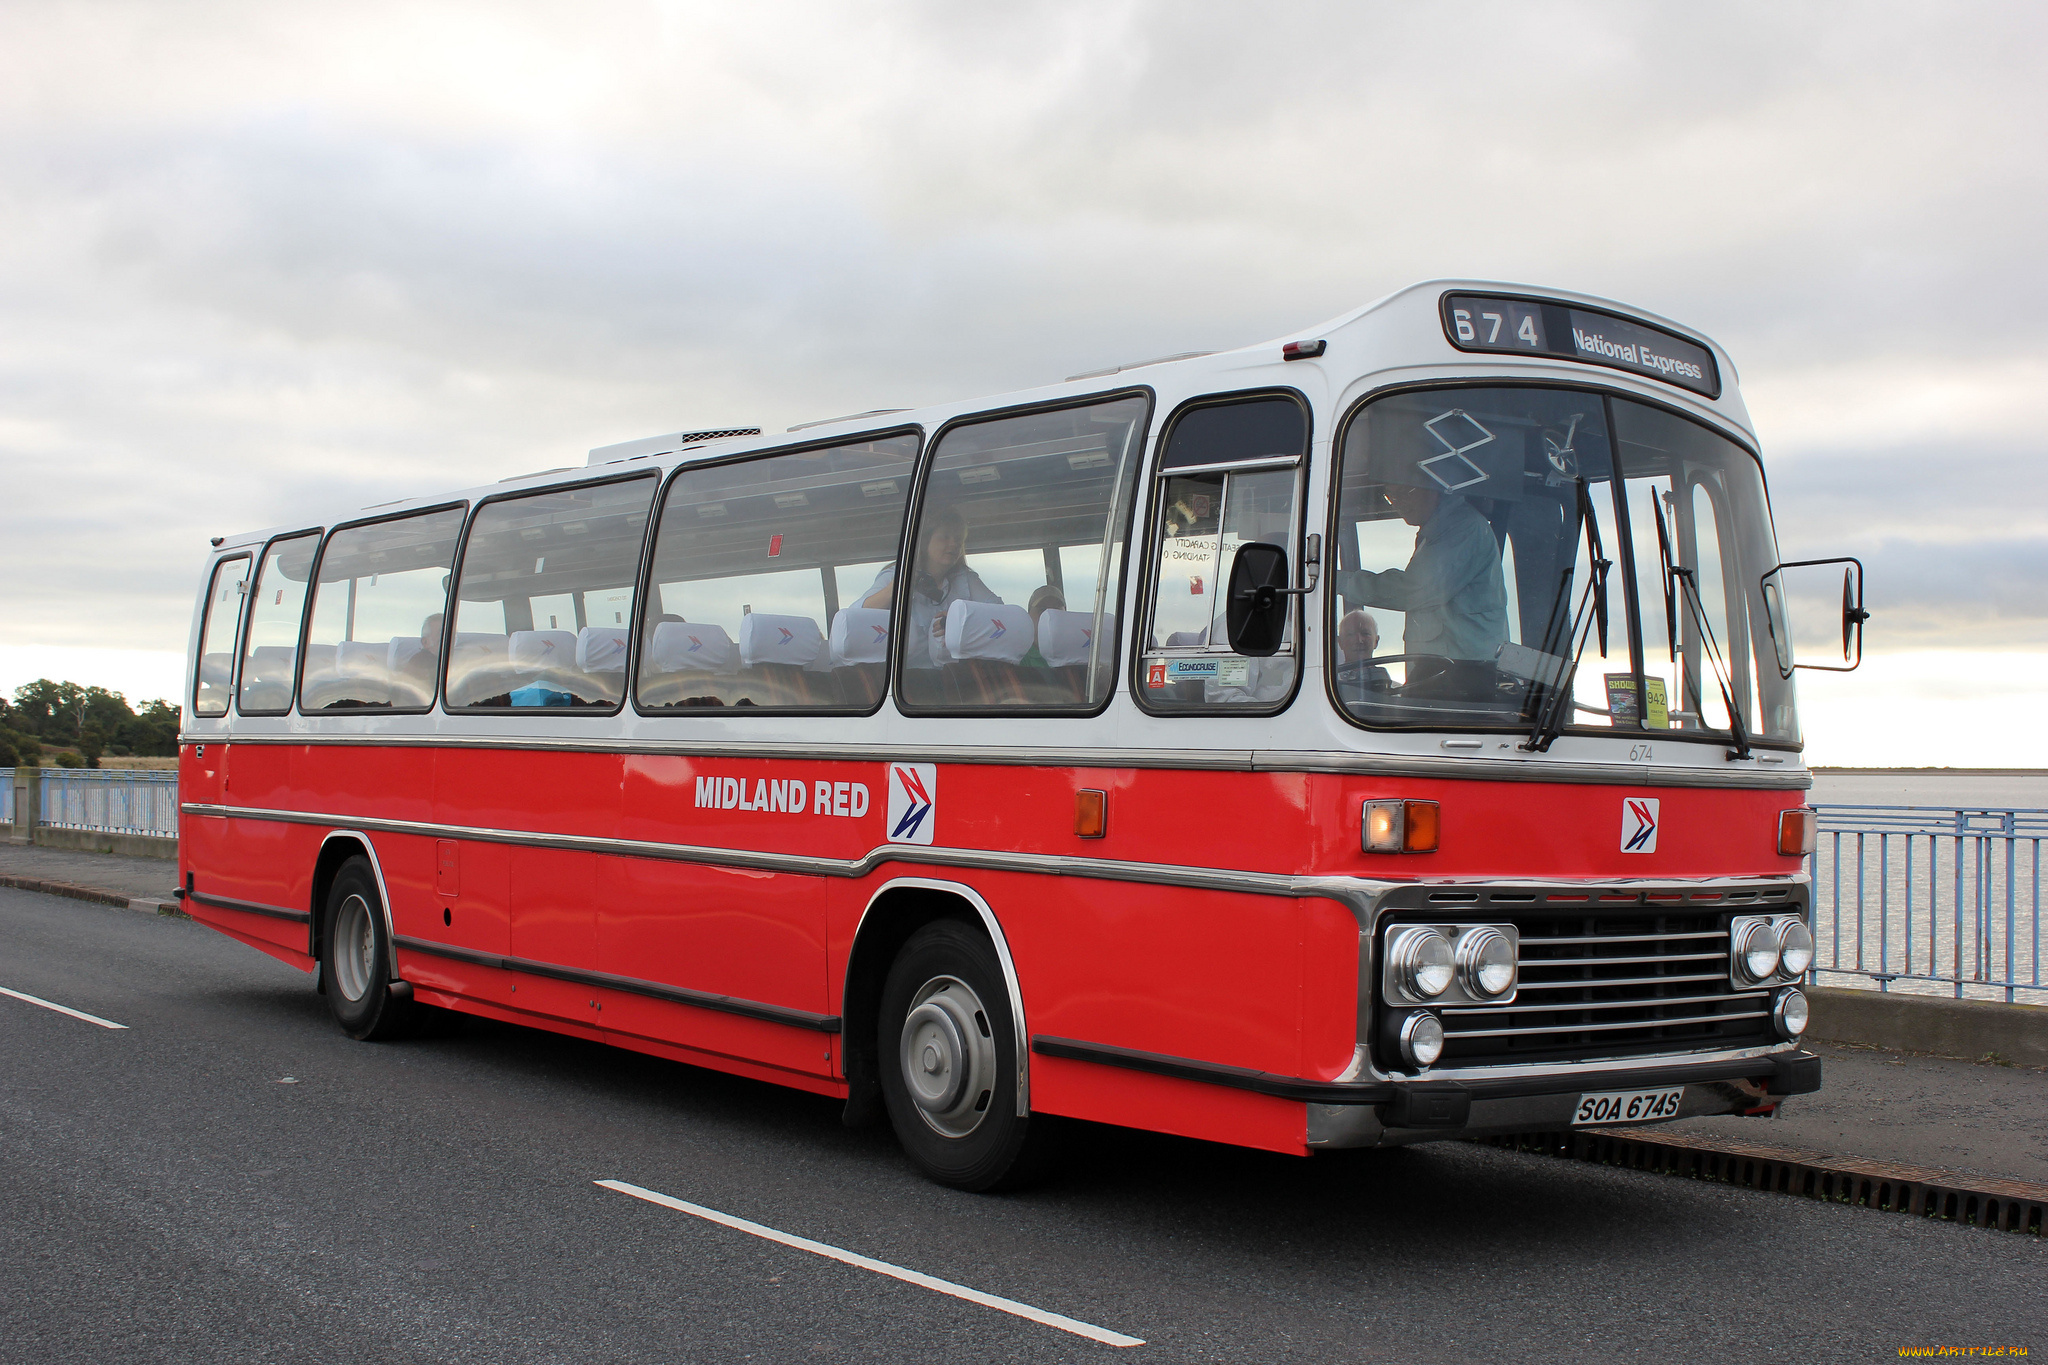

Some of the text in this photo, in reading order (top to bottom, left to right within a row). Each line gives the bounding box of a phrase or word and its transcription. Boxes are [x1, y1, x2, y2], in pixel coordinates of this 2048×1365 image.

[1453, 309, 1538, 347] 674
[1572, 327, 1702, 380] National Express
[1152, 671, 1162, 683] A
[1647, 691, 1666, 706] 942
[1629, 743, 1653, 762] 674
[694, 776, 870, 818] MIDLAND RED
[1578, 1092, 1681, 1121] SOA 674S
